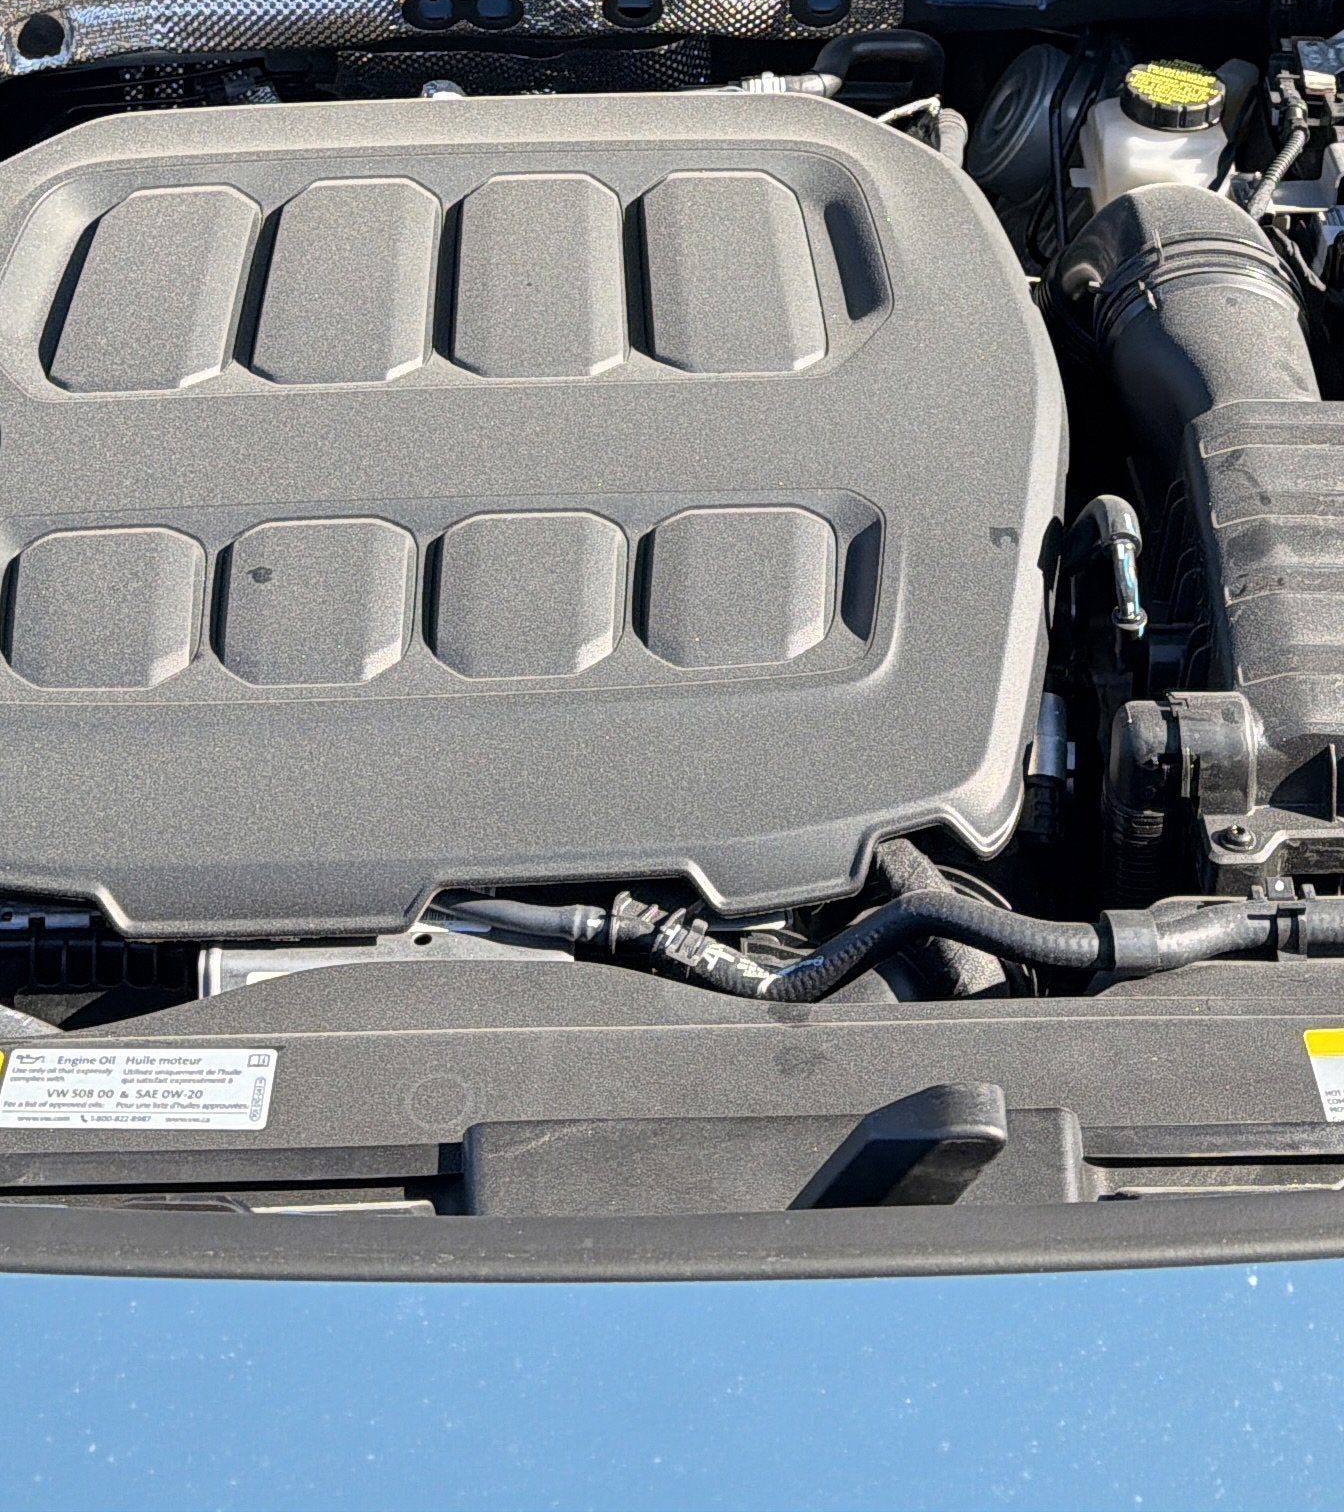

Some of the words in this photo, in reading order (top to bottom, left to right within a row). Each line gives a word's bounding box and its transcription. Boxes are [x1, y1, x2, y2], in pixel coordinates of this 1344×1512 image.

[57, 1056, 97, 1067] Engine
[99, 1056, 116, 1065] Oil
[126, 1056, 156, 1065] Huile
[159, 1056, 203, 1065] moteur
[28, 1067, 46, 1075] only
[46, 1089, 69, 1098] VW
[71, 1089, 94, 1098] 508
[97, 1089, 115, 1098] 00
[119, 1090, 129, 1098] &
[135, 1089, 159, 1099] SAE
[161, 1089, 204, 1099] 0W-20
[1325, 1089, 1342, 1097] HOT
